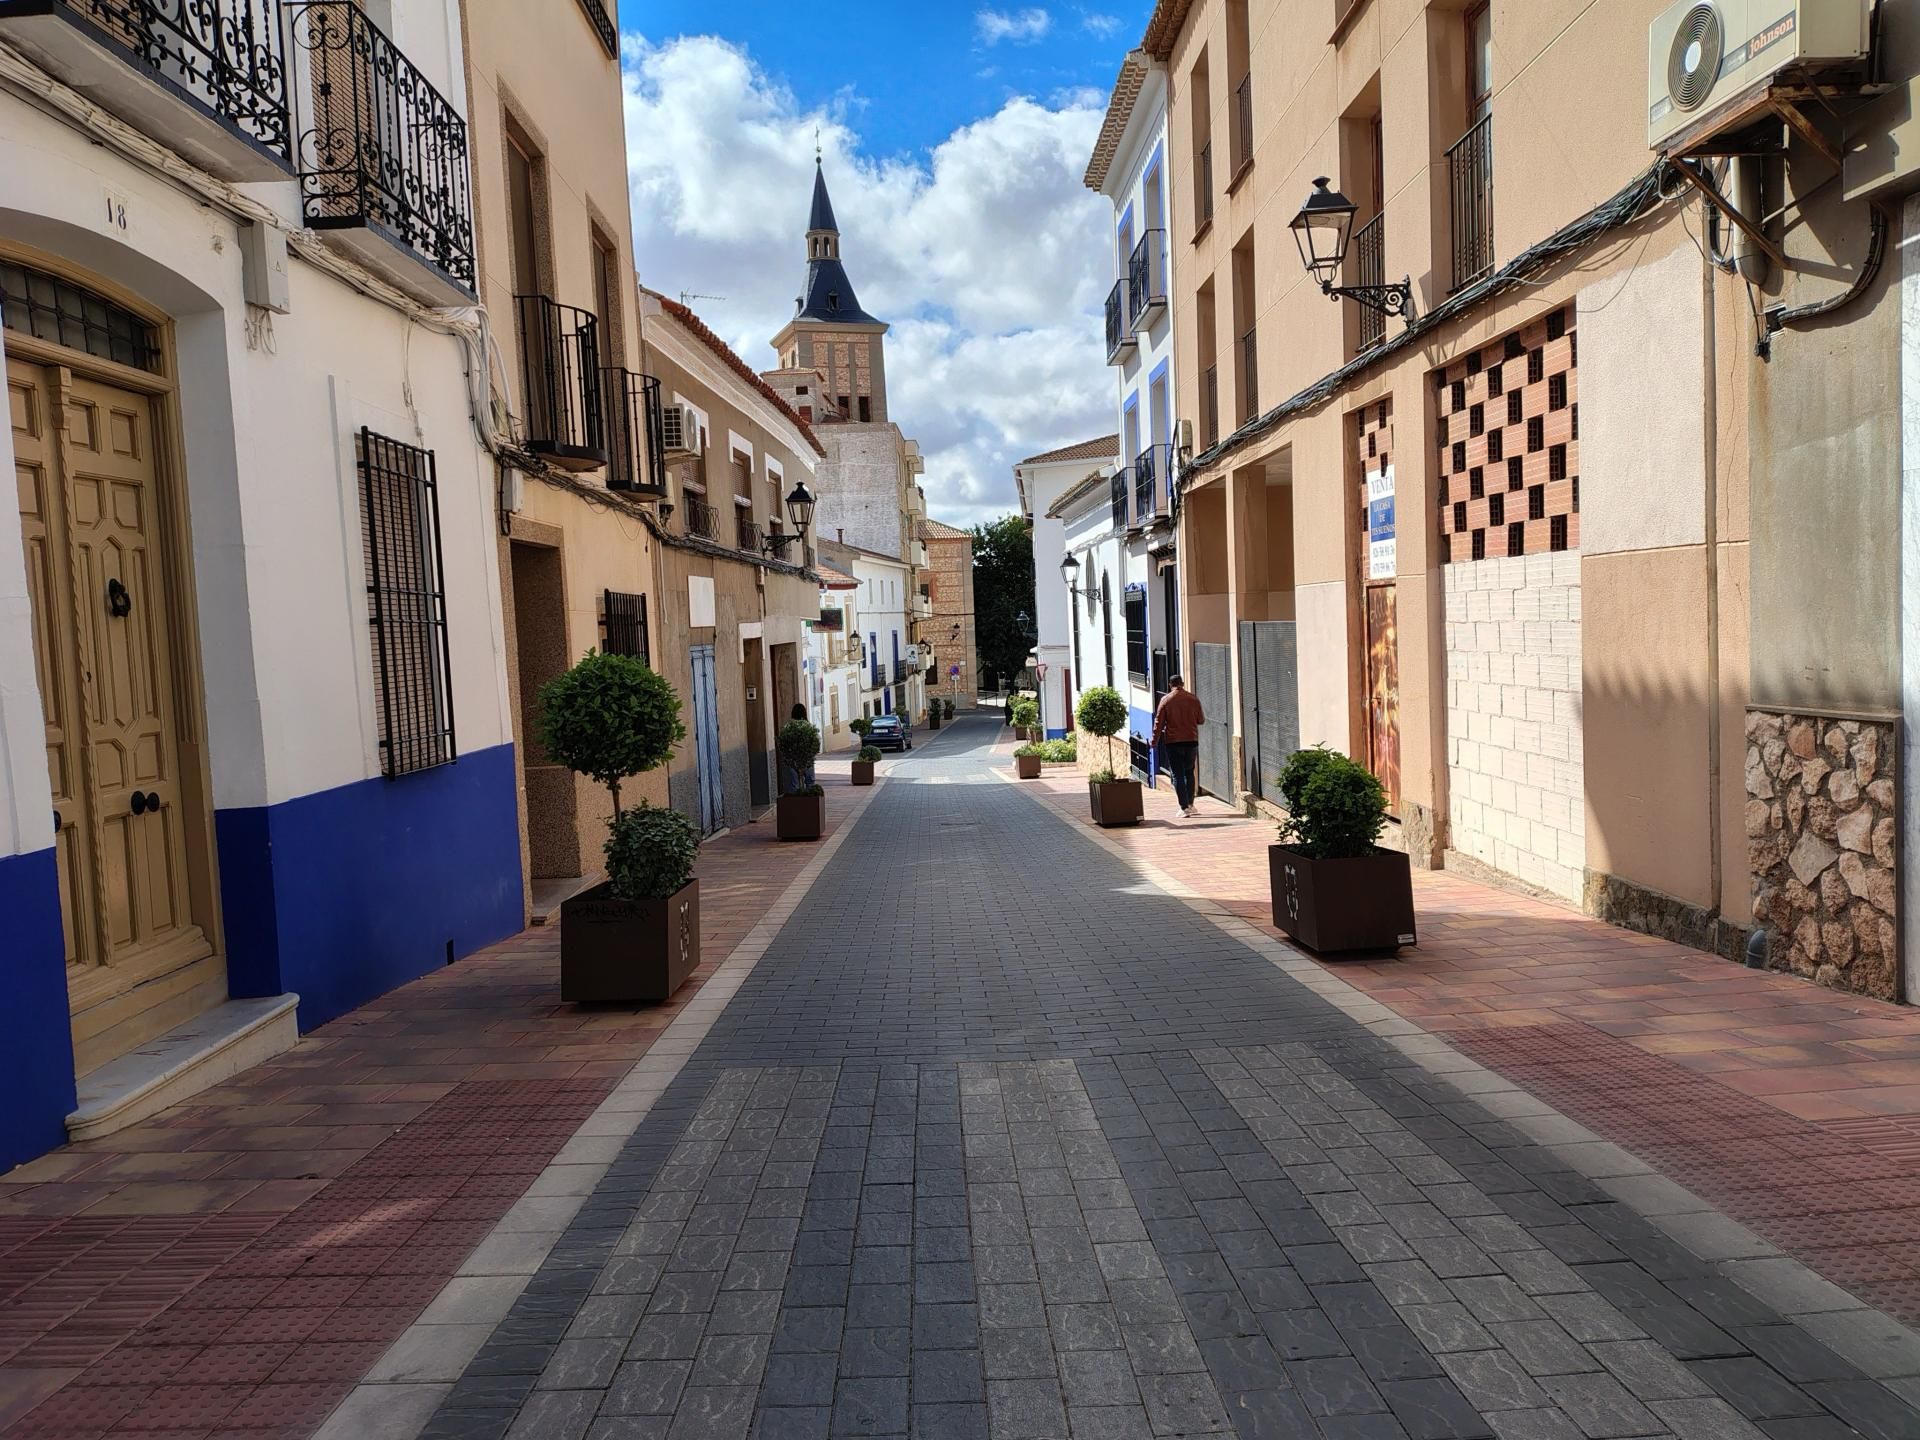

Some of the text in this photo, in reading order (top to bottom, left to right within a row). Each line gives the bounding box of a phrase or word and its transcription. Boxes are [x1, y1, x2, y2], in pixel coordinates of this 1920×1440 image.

[107, 197, 126, 230] 18
[1371, 476, 1394, 495] VENTA
[1379, 513, 1386, 522] DE
